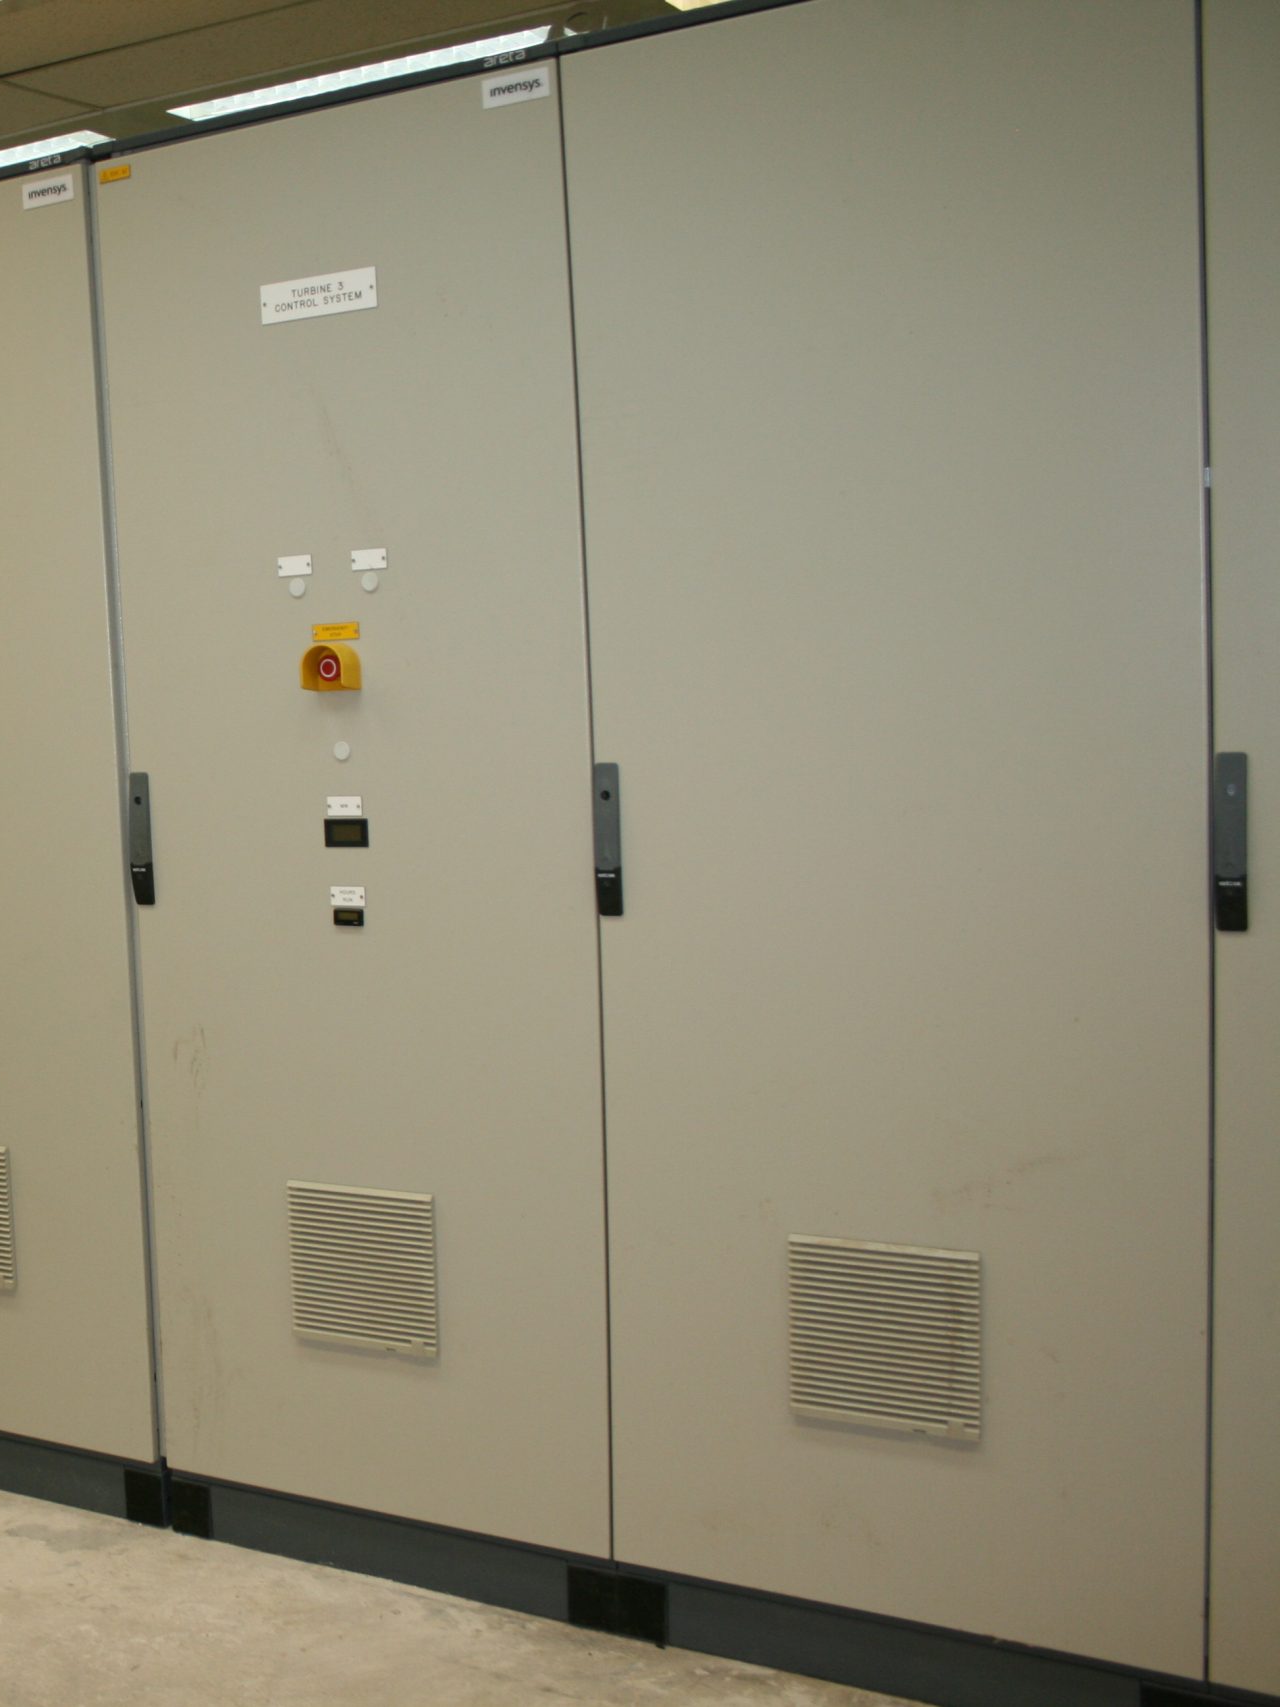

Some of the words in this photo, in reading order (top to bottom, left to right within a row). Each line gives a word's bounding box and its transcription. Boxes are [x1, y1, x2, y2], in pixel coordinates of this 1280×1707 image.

[489, 78, 541, 98] invensys
[28, 183, 67, 200] invensys
[291, 283, 332, 298] TURBINE
[337, 281, 345, 291] 3
[274, 299, 319, 313] CONTROL
[323, 290, 363, 305] SYSTEM
